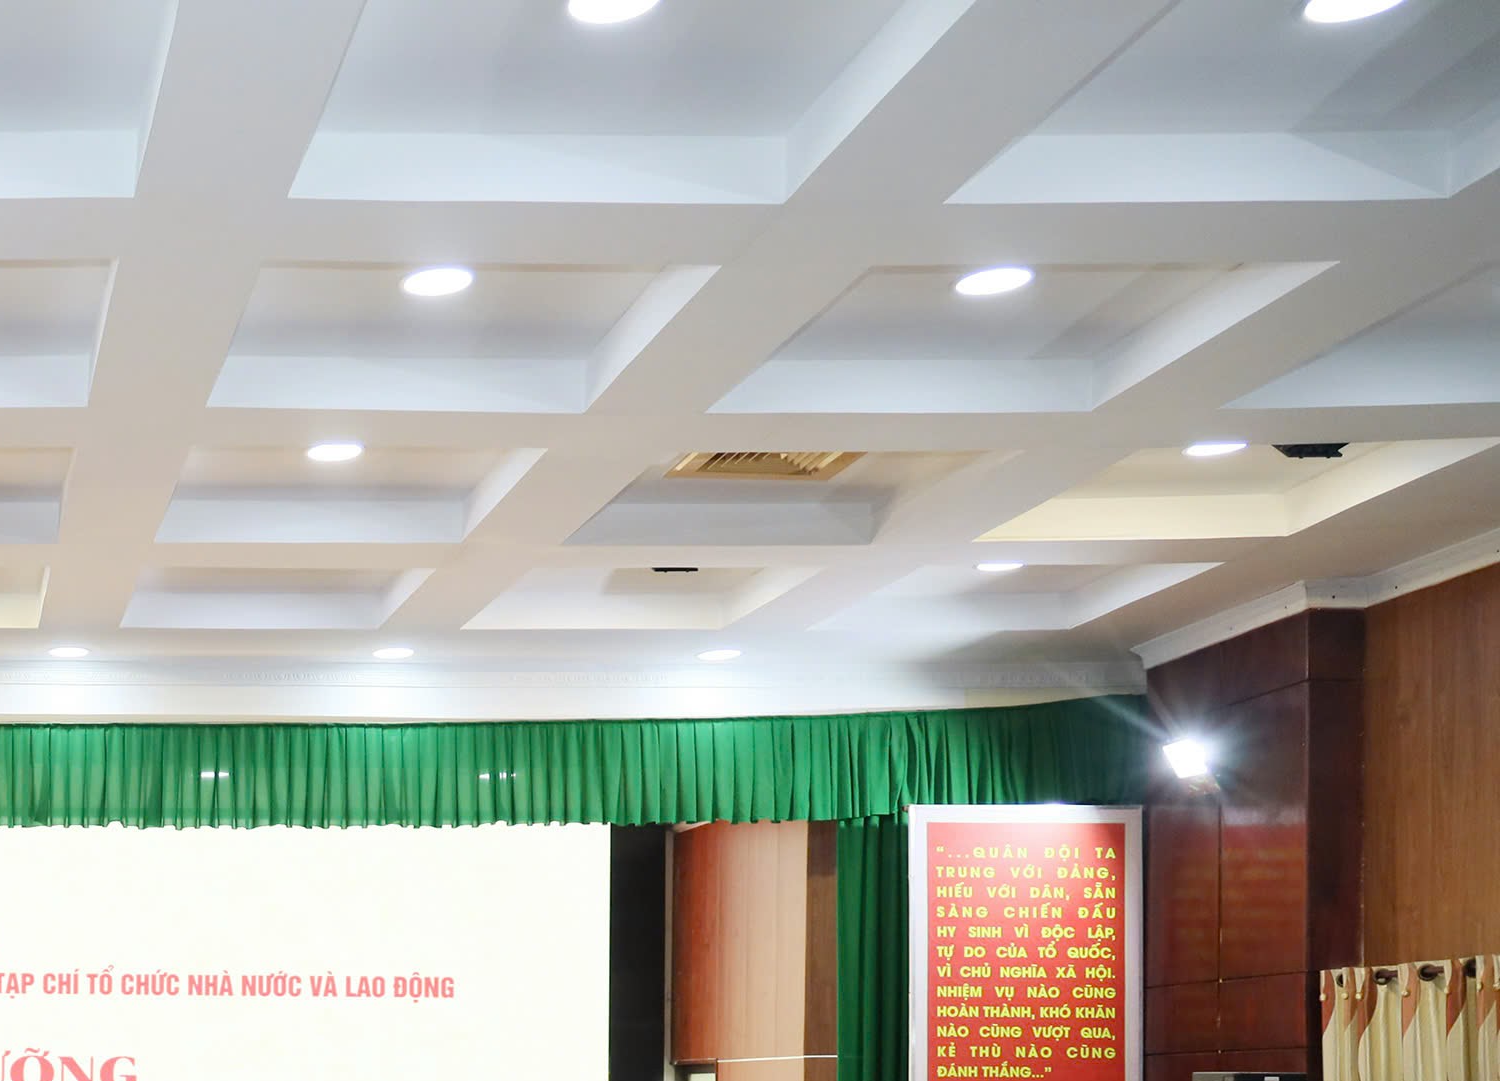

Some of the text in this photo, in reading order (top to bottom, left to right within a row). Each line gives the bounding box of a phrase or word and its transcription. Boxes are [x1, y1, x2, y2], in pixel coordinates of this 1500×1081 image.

[1044, 846, 1079, 861] ĐỘI
[1095, 848, 1116, 858] TA
[936, 864, 1116, 881] TRUNG VỚI ĐẢNG,
[937, 882, 972, 898] HIẾU
[987, 884, 1016, 898] VỚI
[1030, 884, 1070, 901] DÂN,
[936, 903, 1116, 918] SÀNG CHIẾN ĐẤU
[937, 924, 1116, 941] HY SINH VÌ ĐỘC LẬP,
[937, 941, 1116, 962] TỰ DO CỦA TỔ QUỐC,
[937, 963, 1116, 982] VÌ CHỦ NGHĨA XÃ HỘI.
[43, 968, 79, 995] CHÍ
[86, 965, 114, 996] TỔ
[121, 970, 180, 996] CHỨC
[187, 970, 234, 997] NHÀ
[241, 971, 302, 998] NƯỚC
[309, 971, 338, 997] VÀ
[345, 975, 386, 998] LAO
[393, 972, 455, 1003] ĐỘNG
[937, 984, 1116, 1001] NHIỆM VỤ NÀO CŨNG
[937, 1003, 1116, 1020] HOÀN THÀNH, KHÓ KHĂN
[937, 1023, 1116, 1041] NÀO CŨNG VƯỢT QUA,
[937, 1043, 1116, 1058] KẺ THÙ NÀO CŨNG
[937, 1063, 978, 1077] ĐÁNH
